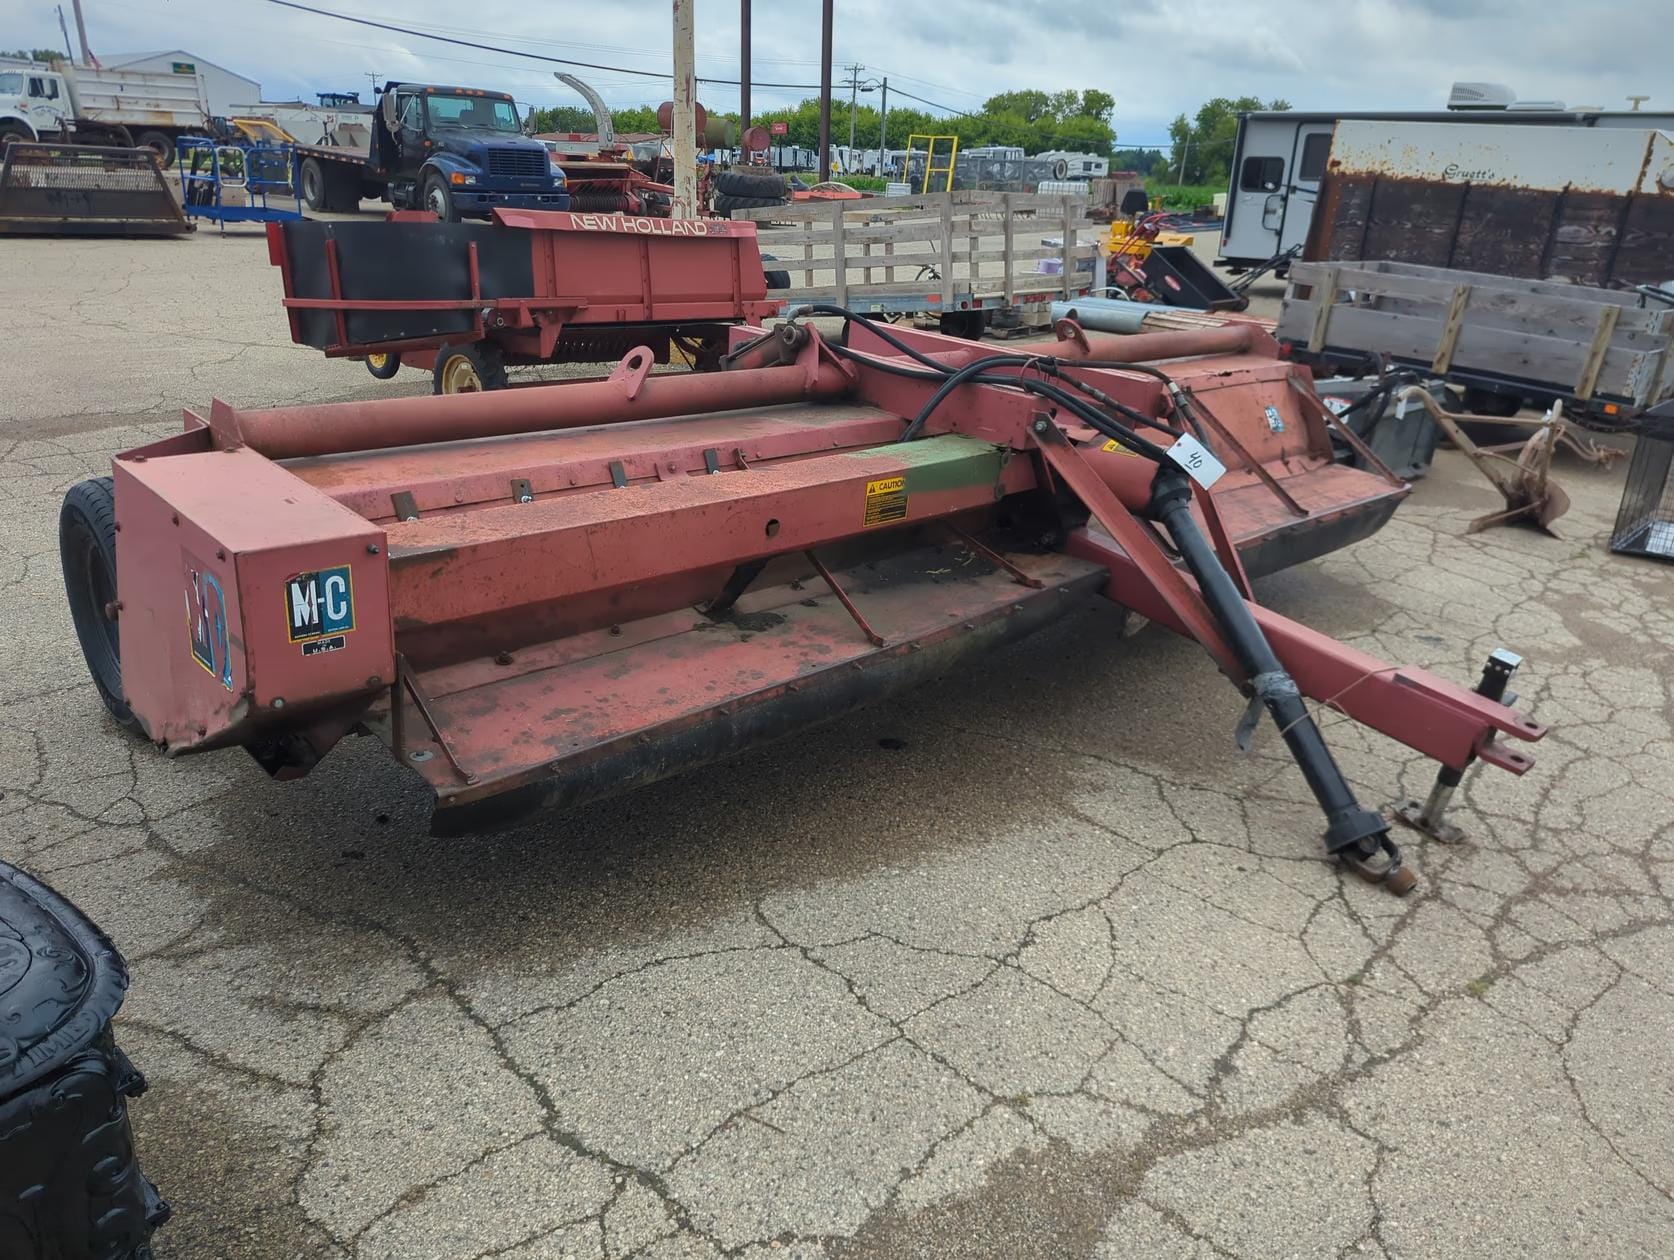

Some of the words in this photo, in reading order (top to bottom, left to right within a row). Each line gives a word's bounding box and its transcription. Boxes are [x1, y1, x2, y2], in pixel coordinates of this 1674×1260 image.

[570, 214, 616, 231] NEW
[622, 217, 708, 236] HOLLAND
[291, 575, 348, 628] M-C
